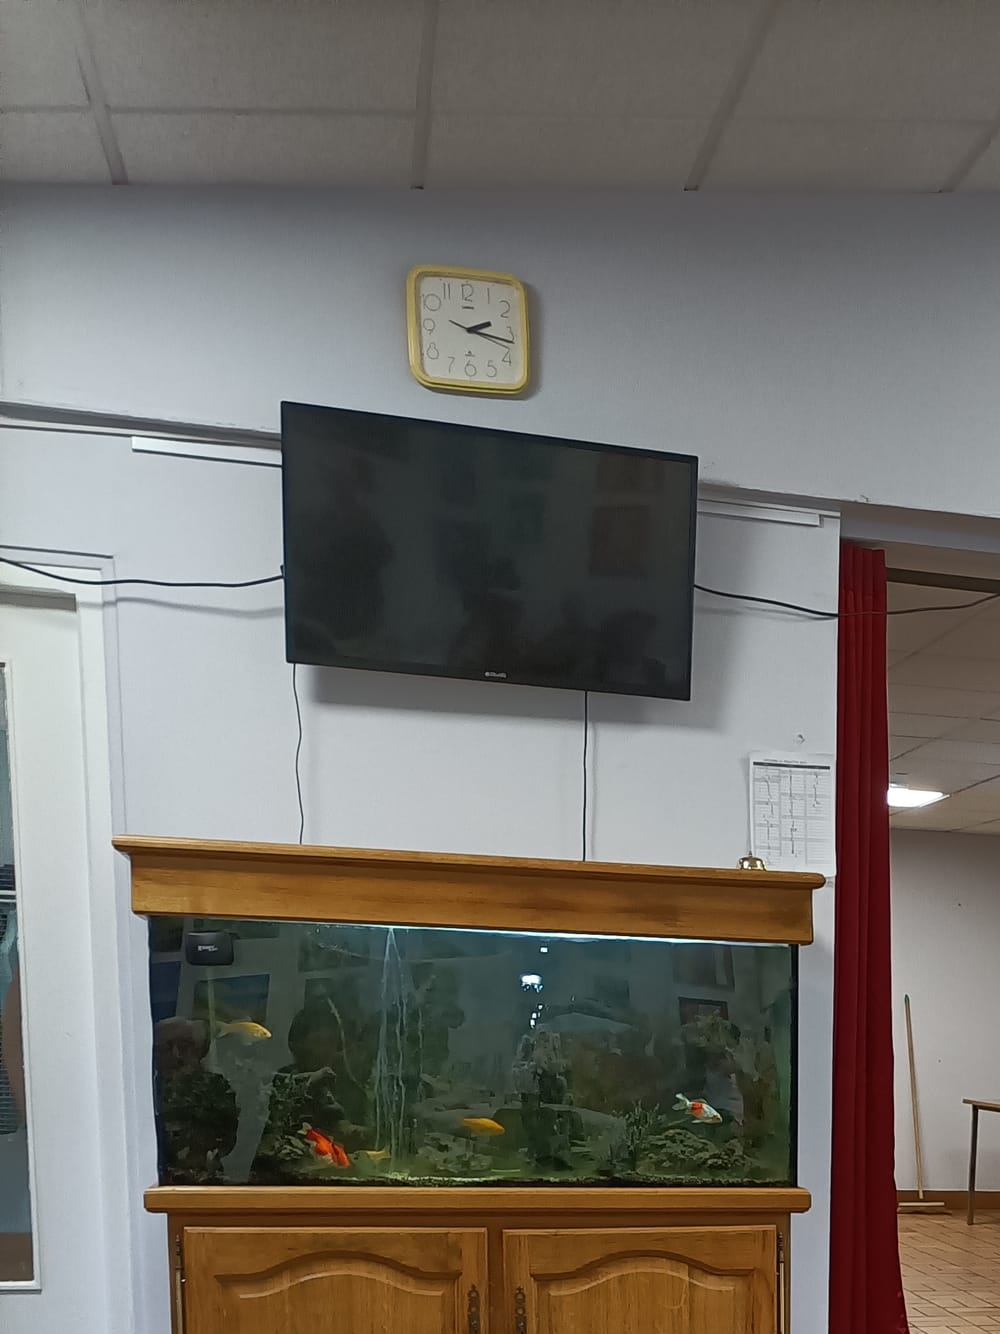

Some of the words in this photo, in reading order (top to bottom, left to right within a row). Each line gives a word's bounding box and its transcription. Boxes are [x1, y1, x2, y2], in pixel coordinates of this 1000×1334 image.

[443, 282, 451, 300] 11
[461, 283, 474, 302] 12
[421, 293, 442, 312] 10
[499, 299, 511, 319] 2
[422, 318, 436, 335] 9
[426, 341, 440, 360] 8
[501, 350, 512, 367] 4
[447, 356, 456, 374] 7
[464, 359, 477, 377] 6
[486, 359, 498, 378] 5
